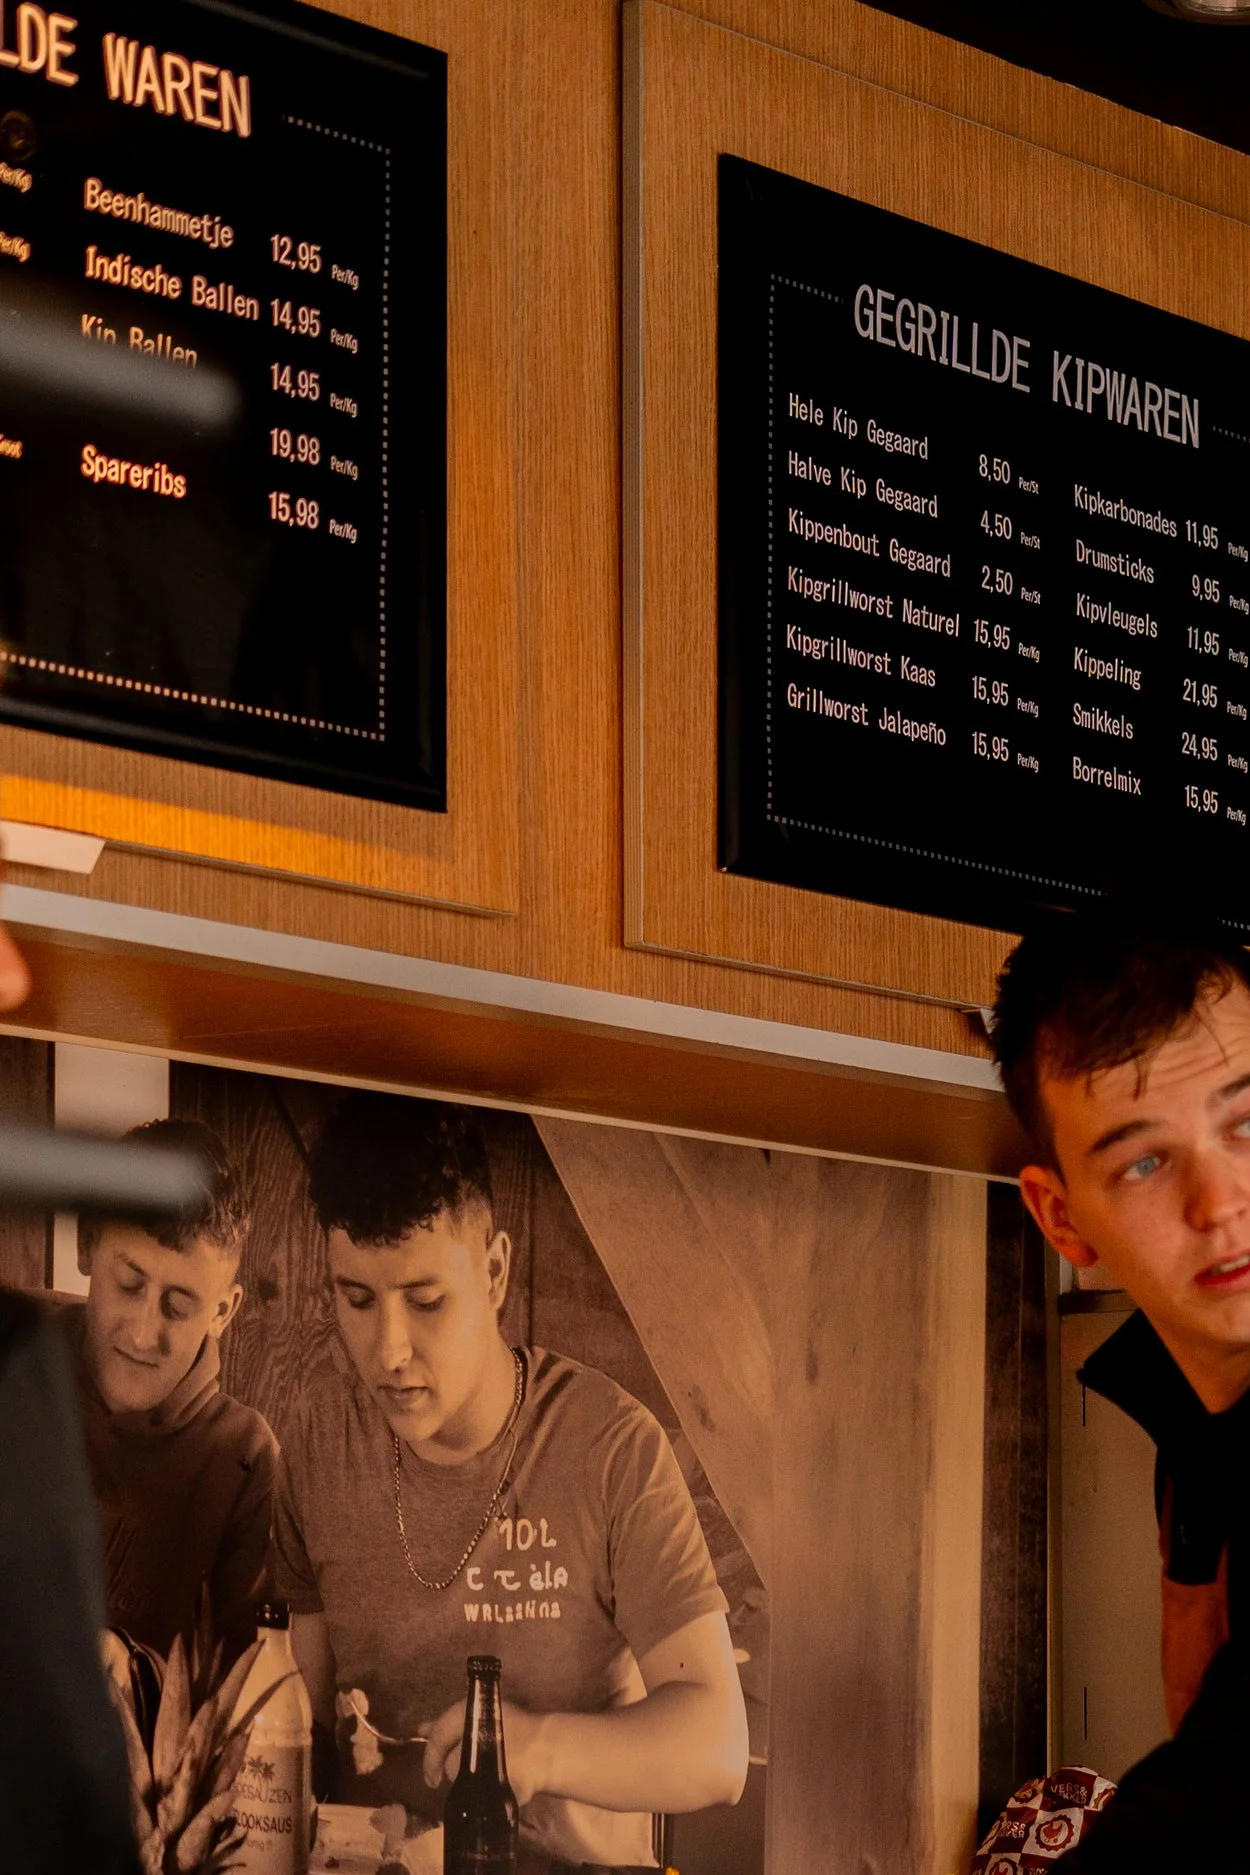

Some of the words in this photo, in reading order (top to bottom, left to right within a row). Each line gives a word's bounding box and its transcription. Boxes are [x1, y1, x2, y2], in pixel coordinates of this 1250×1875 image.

[103, 33, 250, 137] WAREN
[84, 178, 233, 248] Beenhammetje
[271, 235, 321, 273] 12,95
[332, 265, 359, 290] Per/Kg
[86, 246, 181, 298] Indische
[192, 276, 258, 320] Ballen
[271, 299, 320, 337] 14,95
[331, 329, 358, 353] Per/Kg
[271, 363, 320, 400] 14,95
[331, 394, 357, 417] Per/Kg
[855, 284, 1030, 392] GEGRILLDE
[1053, 351, 1198, 448] KIPWAREN
[271, 428, 319, 464] 19,98
[331, 456, 358, 480] Per/Kg
[790, 393, 823, 425] Hele
[833, 407, 857, 439] Kip
[867, 420, 928, 459] Gegaard
[979, 454, 1010, 484] 8,50
[81, 445, 186, 498] Spareribs
[269, 492, 319, 529] 15,98
[330, 520, 357, 543] Per/Kg
[789, 451, 831, 485] Halve
[841, 467, 866, 499] Kip
[876, 479, 938, 518] Gegaard
[980, 511, 1012, 540] 4,50
[1075, 484, 1177, 538] Kipkarbonades
[1186, 520, 1218, 550] 11,95
[789, 508, 879, 557] Kippenbout
[890, 538, 951, 578] Gegaard
[982, 566, 1013, 595] 2,50
[1077, 539, 1154, 584] Drumsticks
[1192, 575, 1220, 602] 9,95
[788, 566, 893, 619] Kipgrillworst
[903, 599, 959, 637] Naturel
[974, 619, 1010, 650] 15,95
[1077, 593, 1157, 638] Kipvleugels
[1188, 627, 1219, 656] 11,95
[787, 624, 891, 676] Kipgrillworst
[901, 656, 936, 687] Kaas
[972, 676, 1009, 706] 15,95
[1074, 647, 1142, 690] Kippeling
[1183, 679, 1217, 709] 21,95
[788, 683, 868, 726] Grillworst
[879, 707, 946, 746] Jalapeño
[972, 732, 1009, 762] 15,95
[1073, 703, 1133, 739] Smikkels
[1182, 732, 1218, 761] 24,95
[1073, 756, 1142, 795] Borrelmix
[1185, 785, 1218, 814] 15,95
